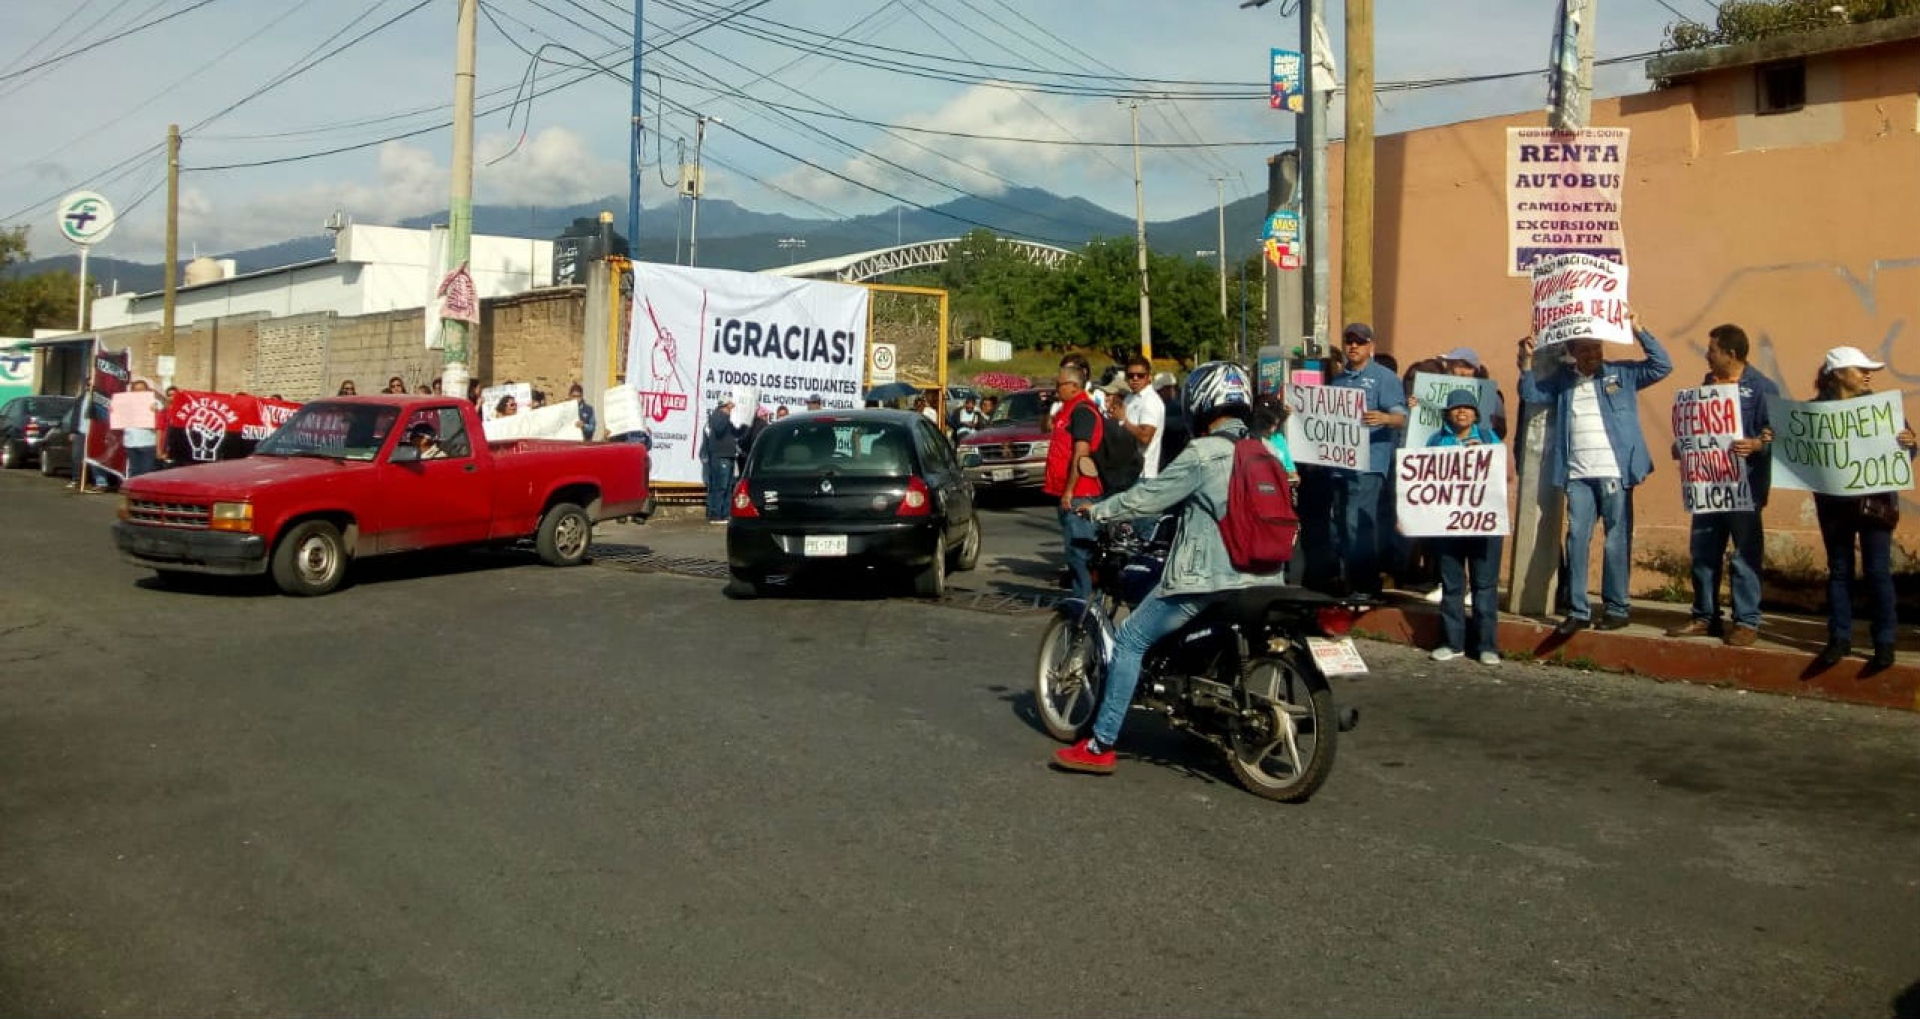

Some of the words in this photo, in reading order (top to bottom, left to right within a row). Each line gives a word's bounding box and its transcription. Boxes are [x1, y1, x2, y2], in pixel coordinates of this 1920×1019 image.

[1520, 144, 1619, 162] RENTA
[1516, 173, 1620, 188] AUTOBUS
[1531, 233, 1573, 243] CADA
[1576, 233, 1603, 243] FIN
[1557, 254, 1615, 274] NACIONAL
[1590, 299, 1605, 319] DE
[1606, 298, 1624, 330] LA
[712, 316, 856, 366] ¡GRACIAS!
[706, 369, 715, 383] A
[718, 370, 758, 388] TODOS
[759, 375, 781, 389] LOS
[783, 376, 857, 395] ESTUDIANTES
[1698, 389, 1719, 399] LA
[1294, 385, 1364, 420] STAUAEM
[1303, 416, 1361, 447] CONTU
[1788, 400, 1896, 441] STAUAEM
[1318, 443, 1357, 468] 2018
[1698, 437, 1720, 449] LA
[1784, 438, 1849, 470] CONTU
[1401, 449, 1494, 482] STAUAEM
[1844, 450, 1911, 490] 2018
[1406, 483, 1487, 508] CONTU
[1446, 510, 1498, 532] 2018
